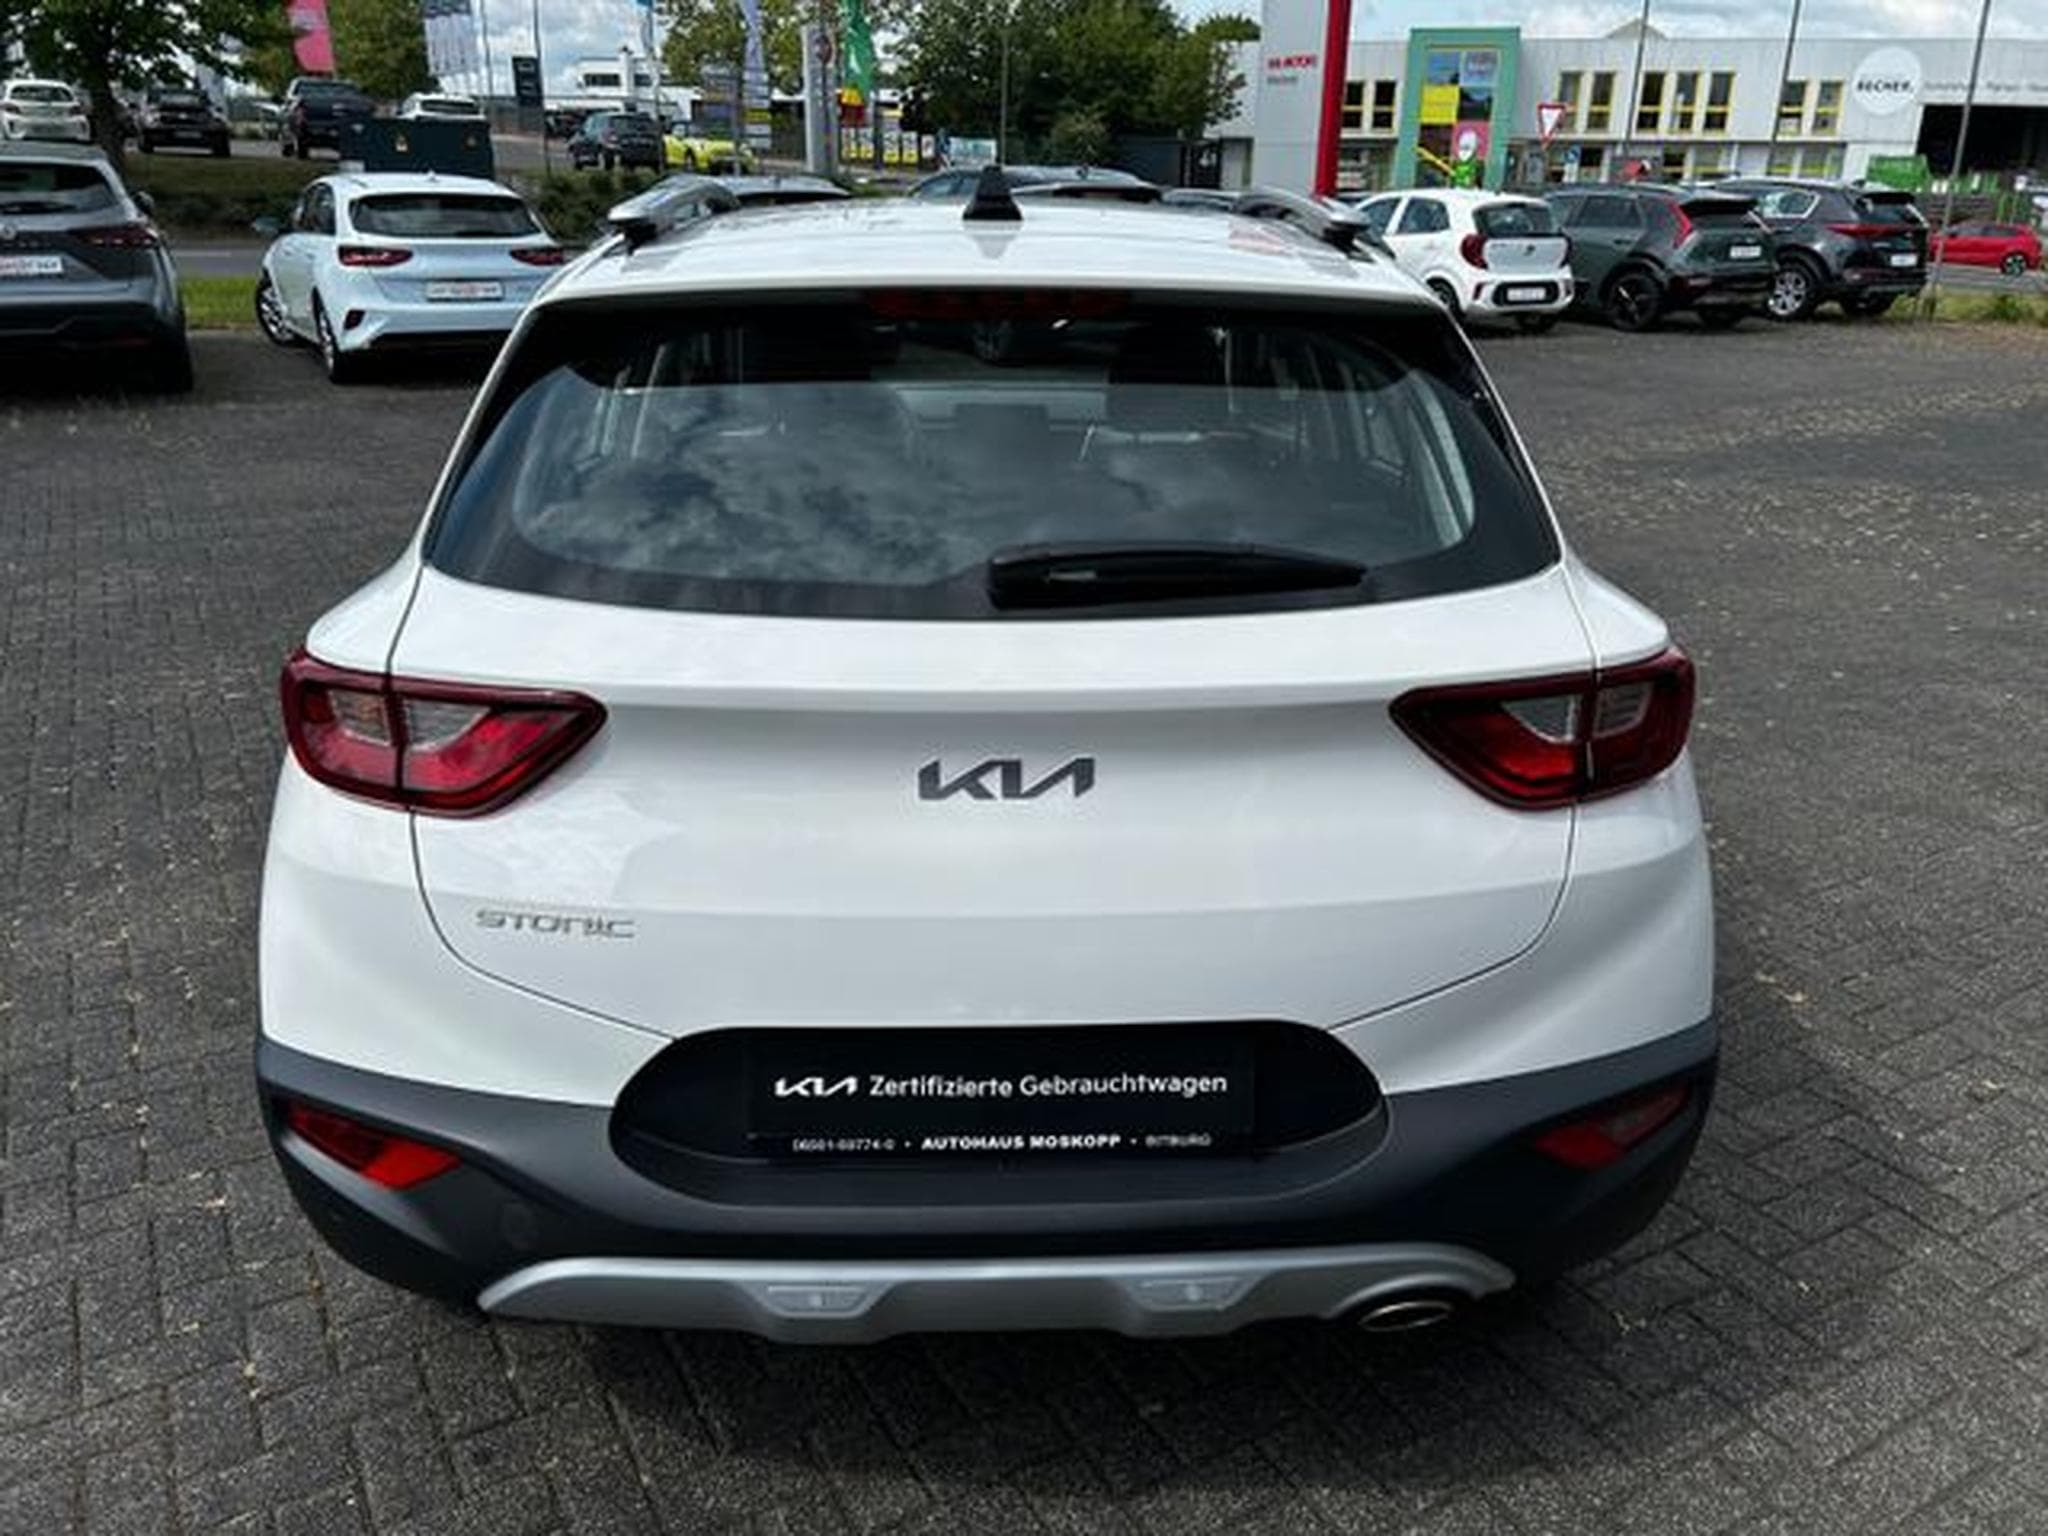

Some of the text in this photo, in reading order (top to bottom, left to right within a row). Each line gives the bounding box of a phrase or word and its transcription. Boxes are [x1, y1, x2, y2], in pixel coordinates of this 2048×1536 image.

[475, 910, 635, 939] STONIC
[869, 1074, 1013, 1098] Zertifizierte
[1019, 1073, 1228, 1098] Gebrauchtwagen
[921, 1135, 1025, 1150] AUTOHAUS
[1029, 1133, 1121, 1149] MOSKOPP
